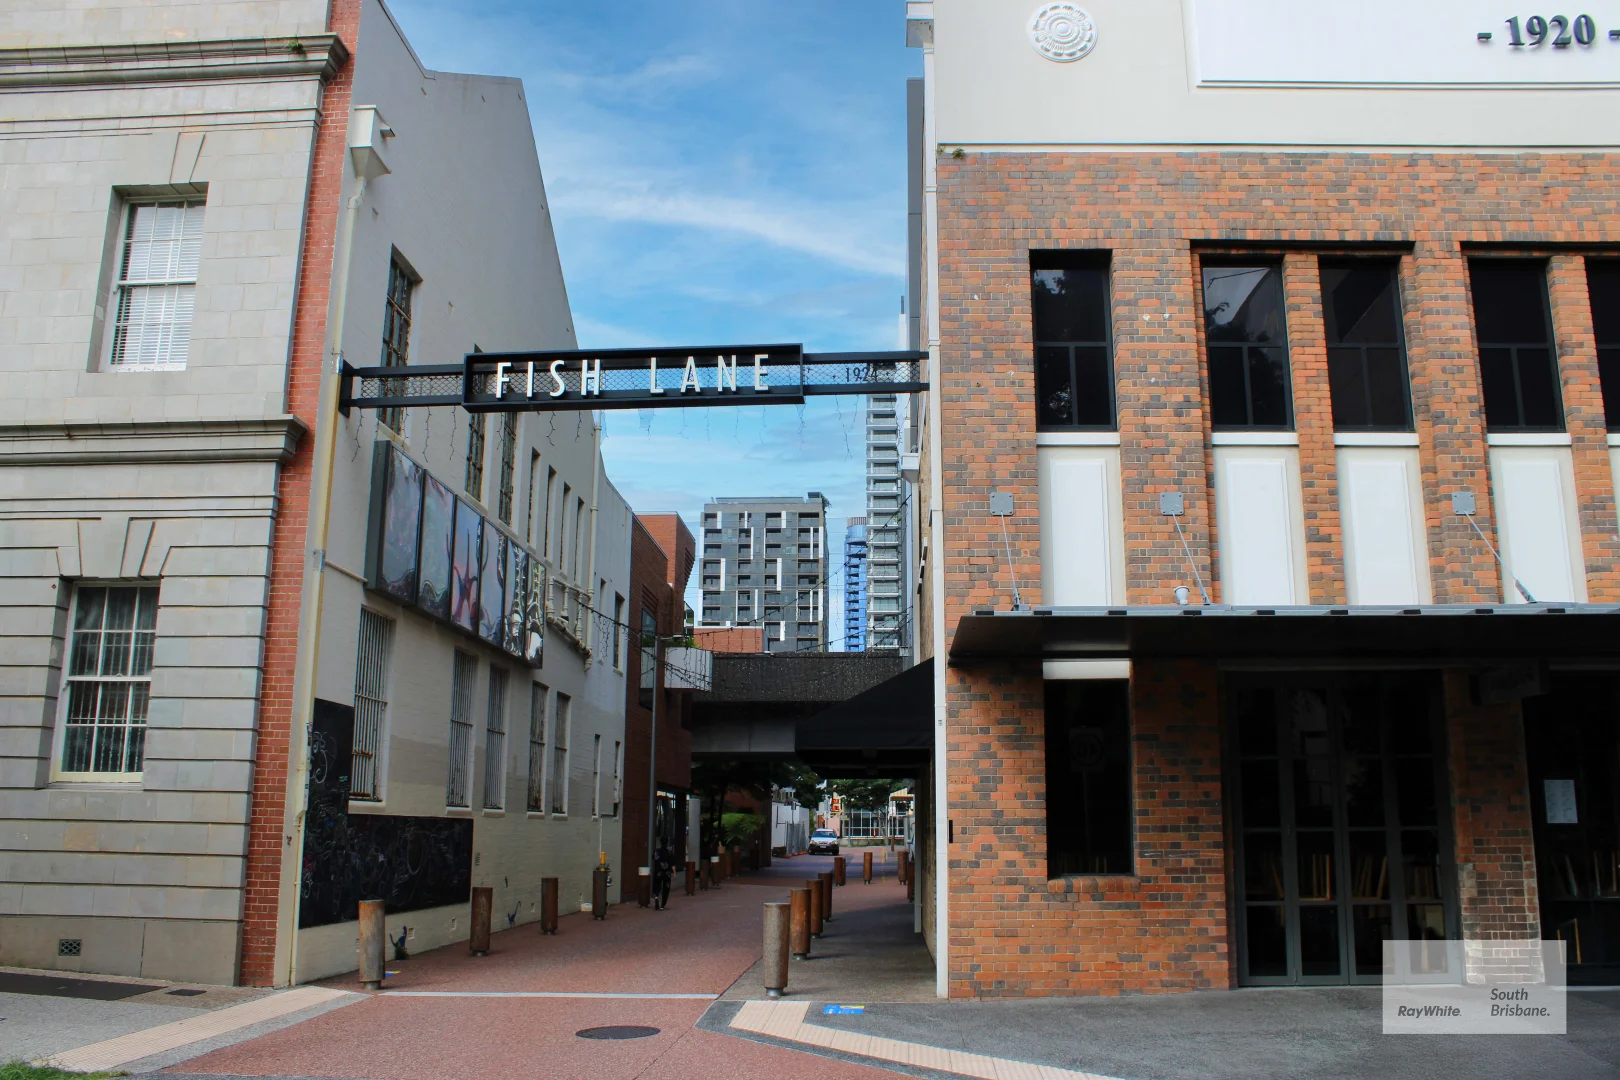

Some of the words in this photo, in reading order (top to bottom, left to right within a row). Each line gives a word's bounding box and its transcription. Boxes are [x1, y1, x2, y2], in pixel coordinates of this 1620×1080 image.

[1505, 14, 1596, 46] 1920
[496, 359, 600, 398] FISH
[650, 354, 768, 393] LANE
[845, 366, 878, 382] 1924
